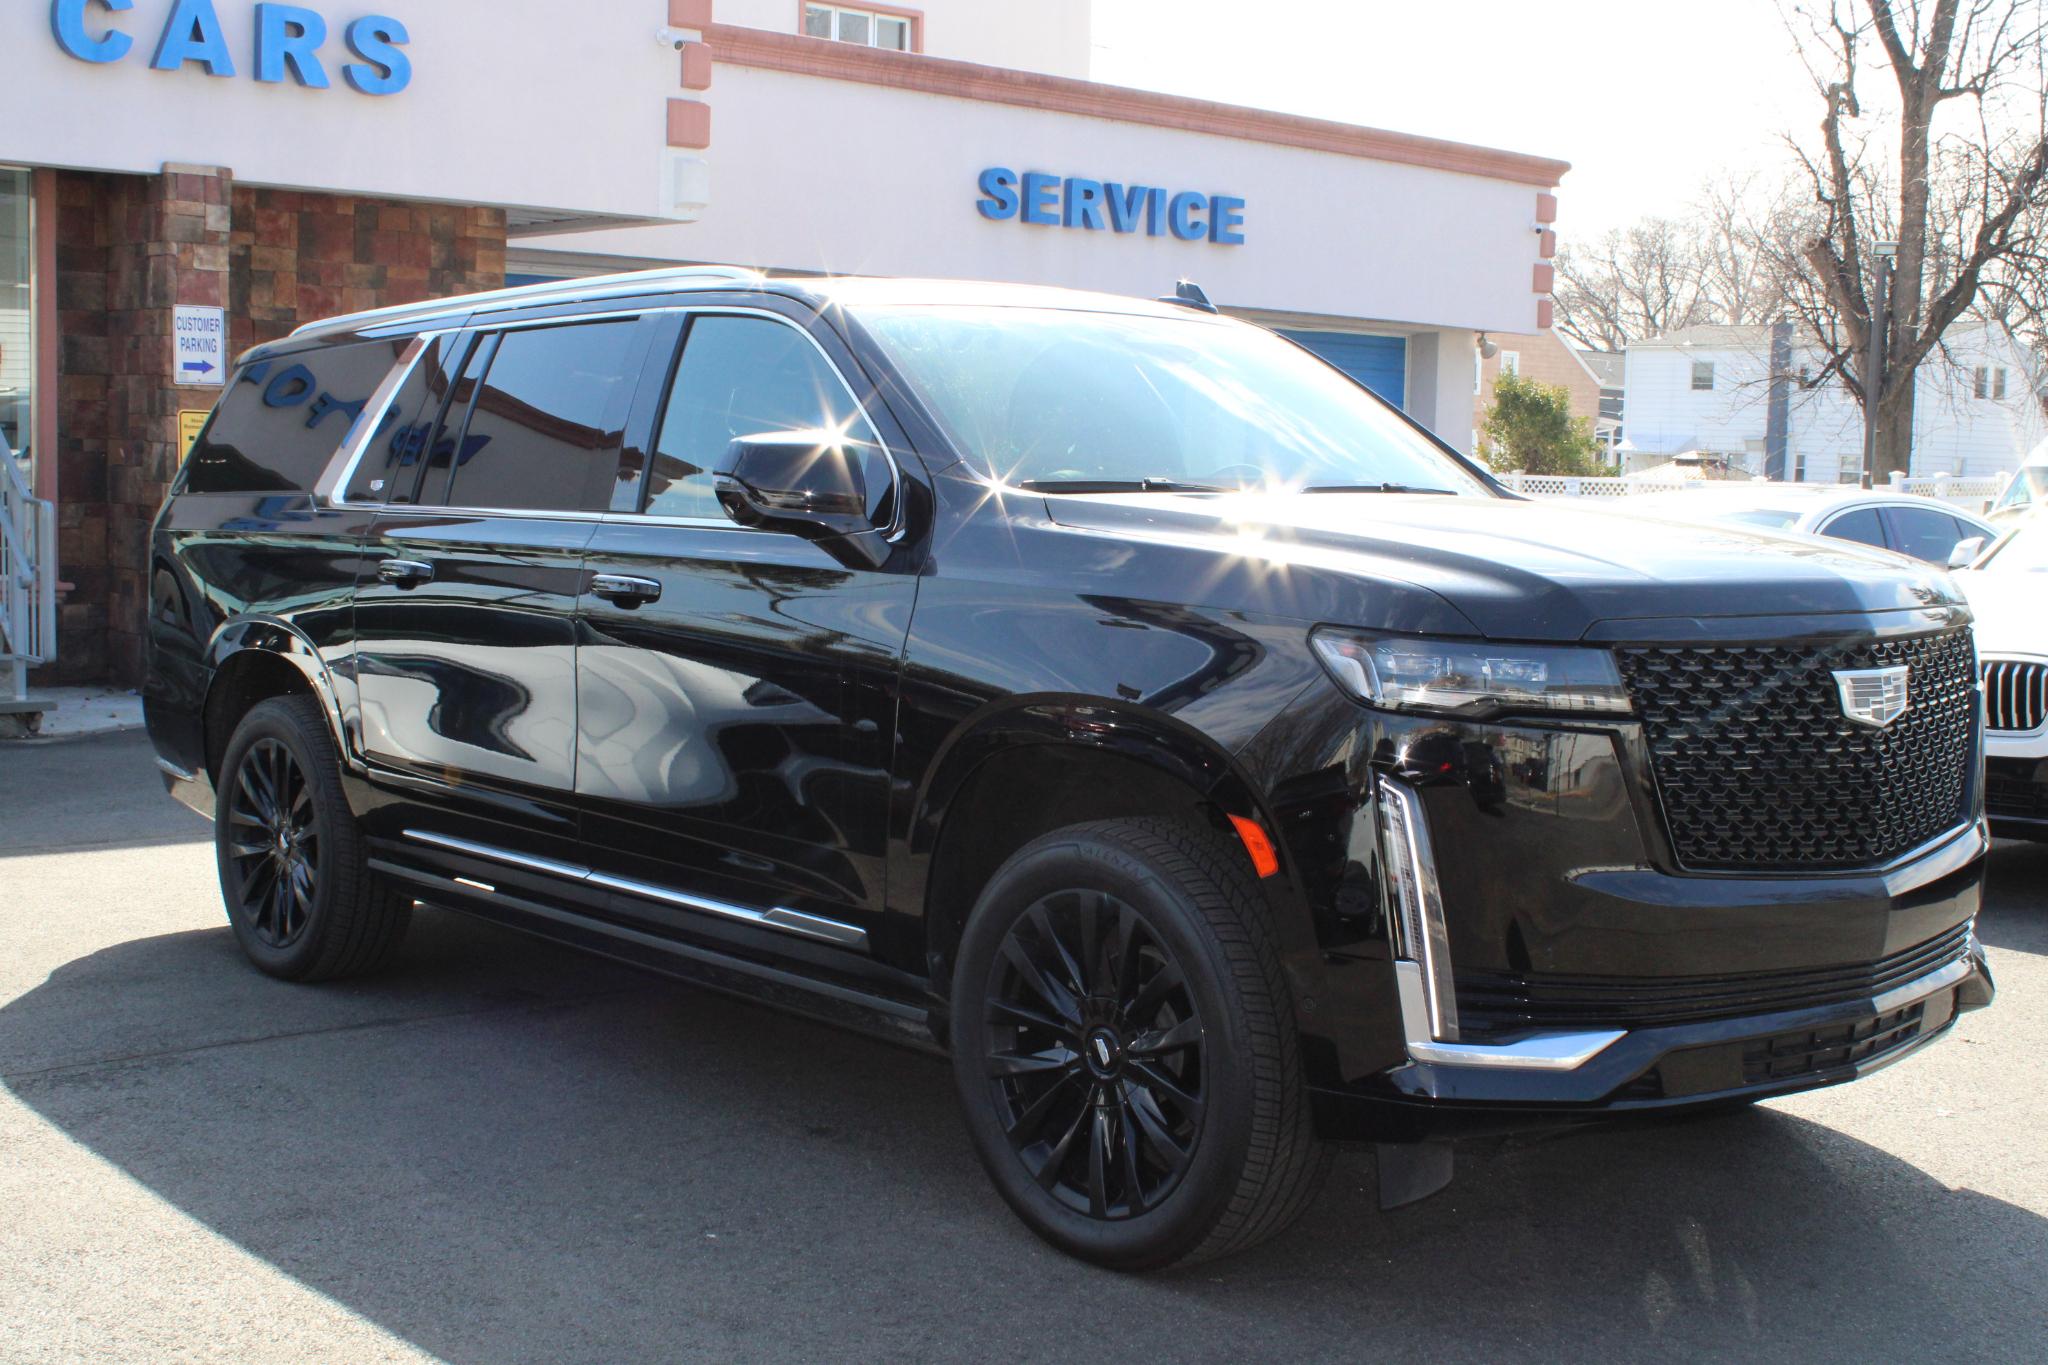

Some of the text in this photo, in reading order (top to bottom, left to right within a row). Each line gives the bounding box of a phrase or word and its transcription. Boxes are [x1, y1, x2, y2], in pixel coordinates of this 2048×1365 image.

[49, 0, 412, 96] CARS
[976, 167, 1245, 245] SERVICE
[176, 316, 221, 333] CUSTOMER
[180, 337, 217, 353] PARKING
